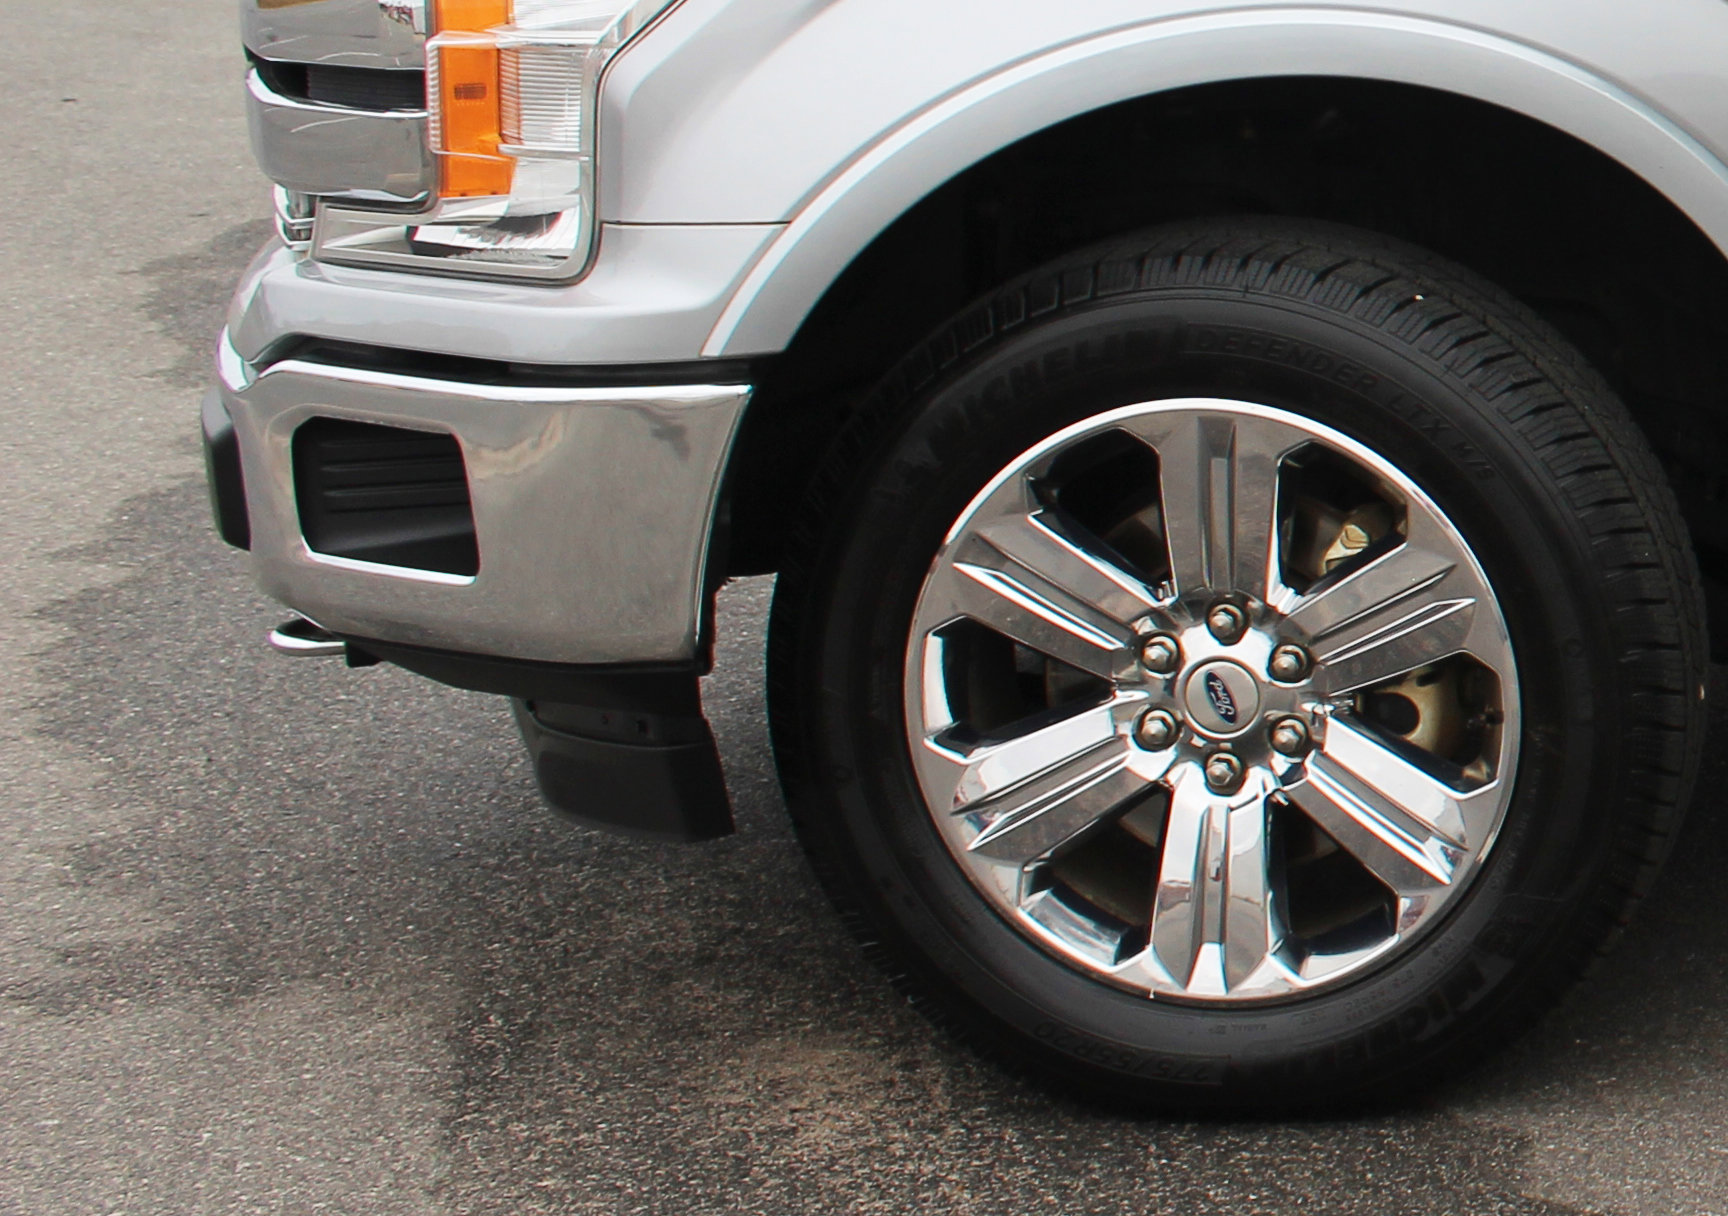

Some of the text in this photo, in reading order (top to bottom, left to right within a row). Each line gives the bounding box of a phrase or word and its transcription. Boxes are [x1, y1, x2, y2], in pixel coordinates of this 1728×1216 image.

[1196, 328, 1379, 396] DEFENDER
[1387, 390, 1452, 442] LTX
[1207, 679, 1235, 715] Ford
